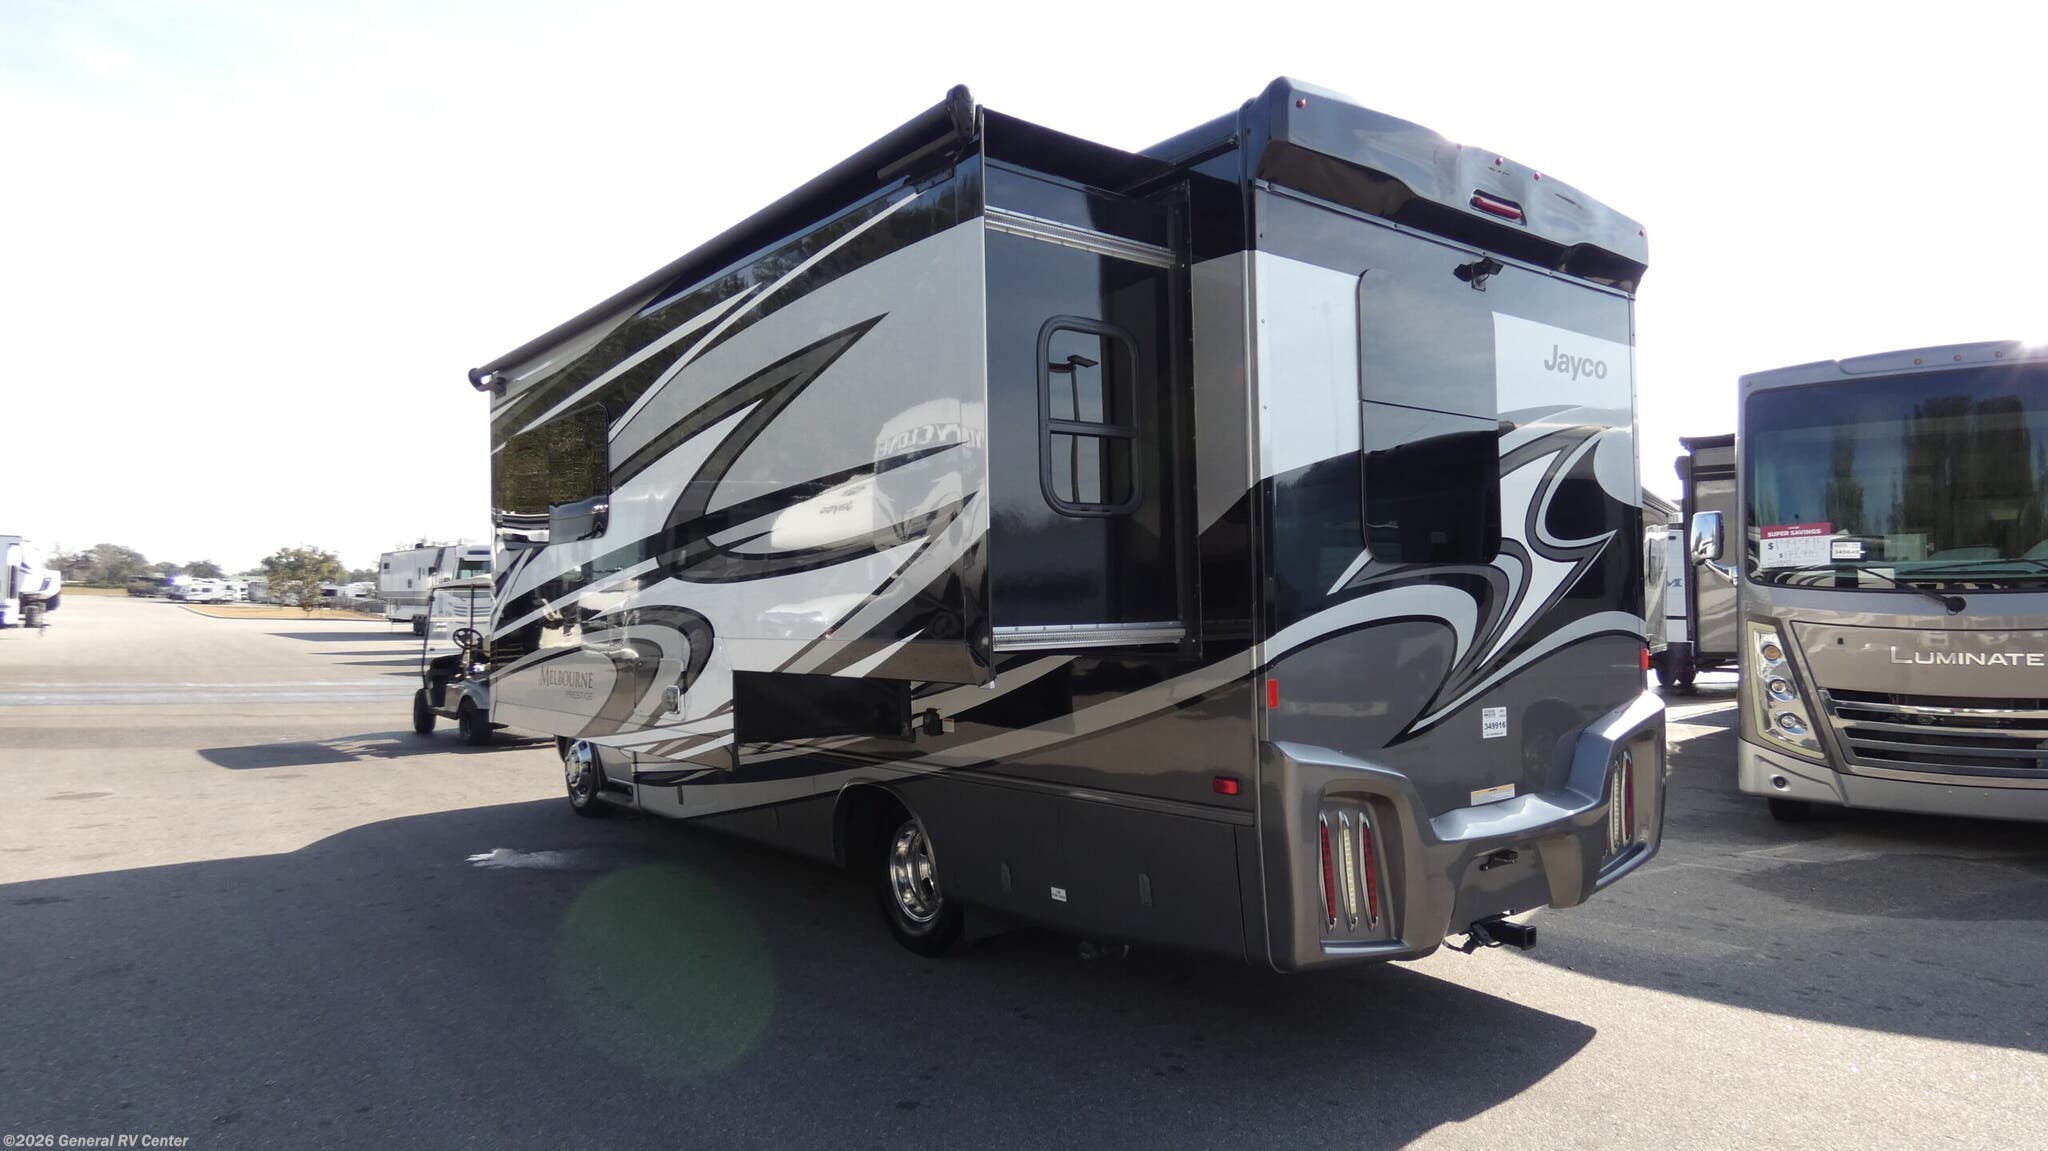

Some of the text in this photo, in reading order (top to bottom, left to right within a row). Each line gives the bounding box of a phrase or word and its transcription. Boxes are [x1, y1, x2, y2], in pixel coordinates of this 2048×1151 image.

[1544, 344, 1607, 381] Jayco
[1767, 530, 1789, 538] SUPER
[1790, 528, 1822, 536] SAVINGS
[1891, 646, 2045, 666] LUMINATE
[540, 664, 593, 688] MELBOURNE
